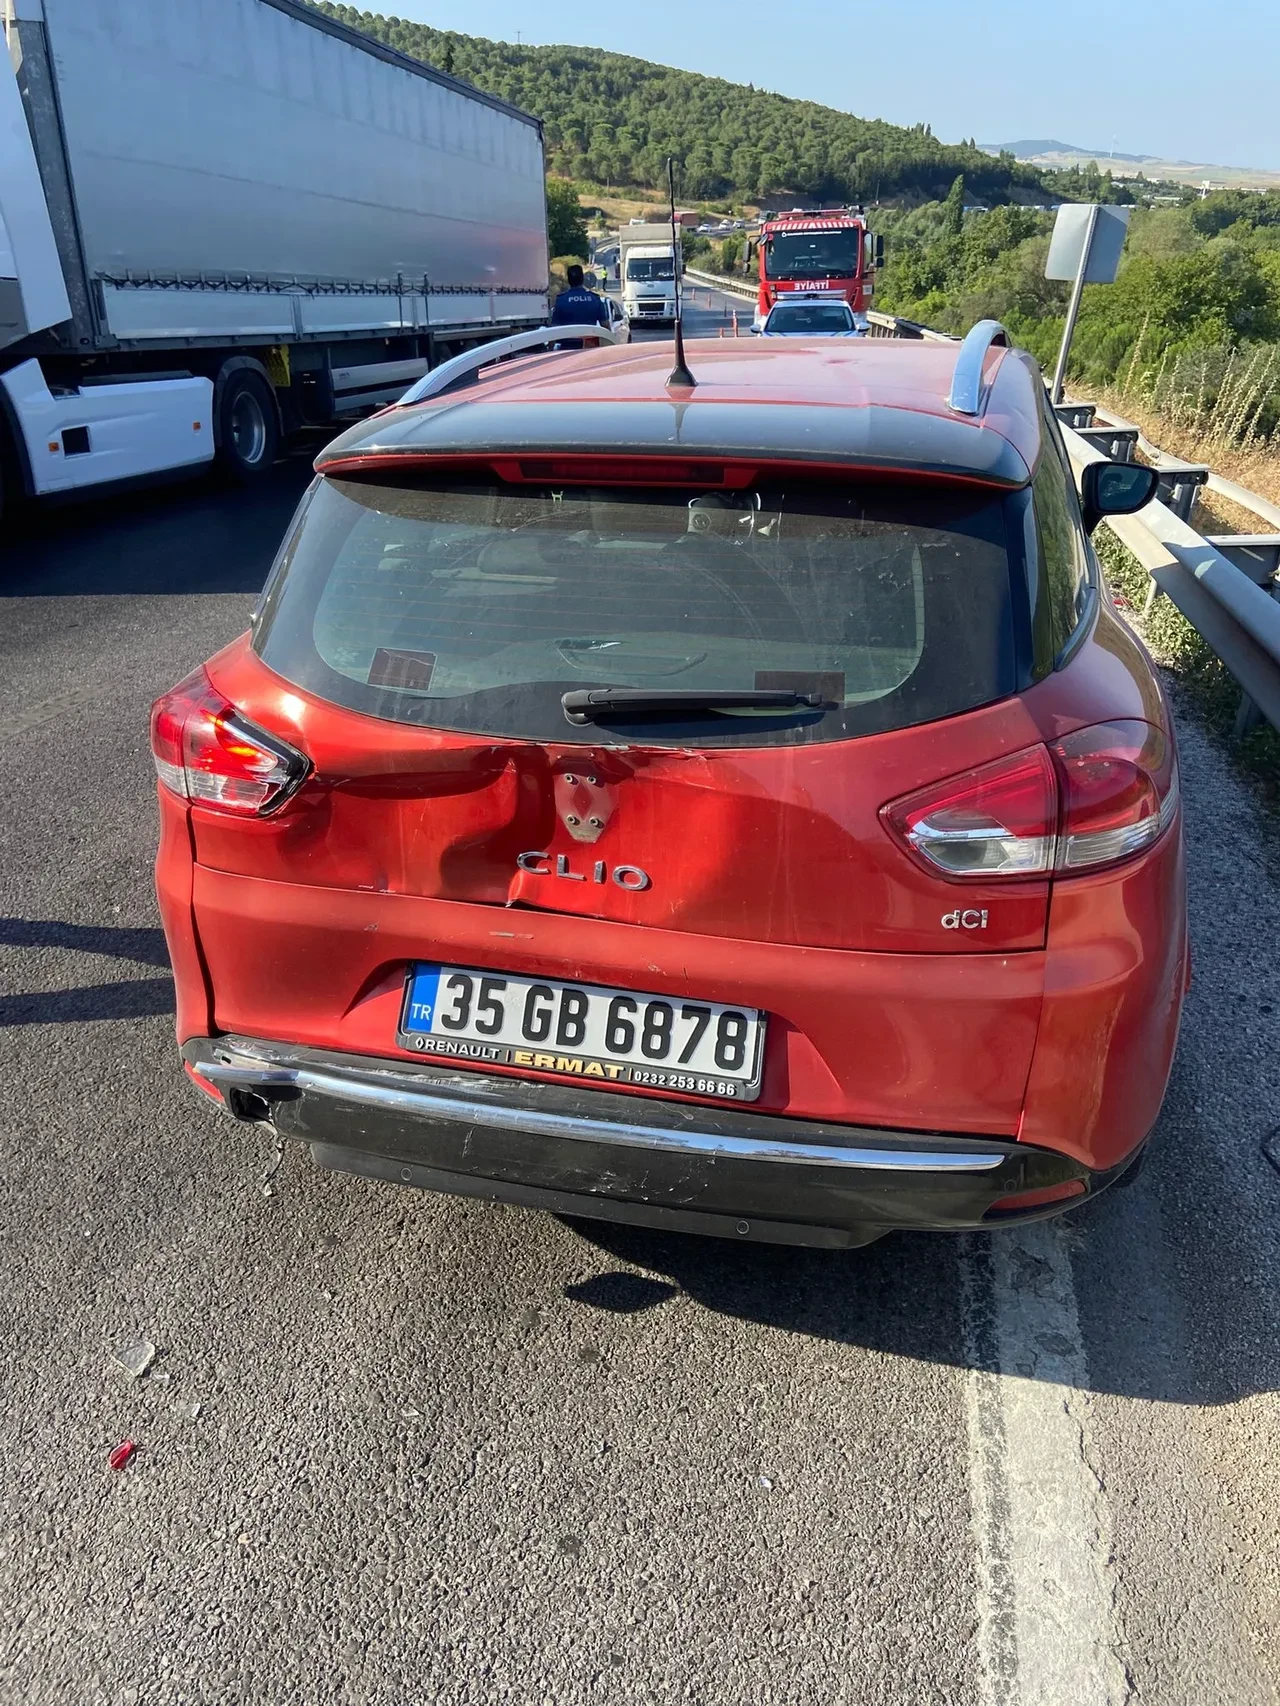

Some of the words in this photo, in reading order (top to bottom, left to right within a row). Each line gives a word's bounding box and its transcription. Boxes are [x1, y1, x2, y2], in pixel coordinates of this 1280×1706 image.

[517, 851, 649, 891] CLIO
[412, 1003, 432, 1021] TR
[441, 974, 507, 1035] 35
[522, 984, 588, 1046] GB
[605, 996, 748, 1071] 6878
[425, 1039, 500, 1060] RENAULT
[514, 1050, 624, 1079] ERMAT
[634, 1071, 667, 1085] 0232
[669, 1075, 695, 1089] 253
[697, 1079, 715, 1093] 66
[717, 1082, 736, 1096] 66
